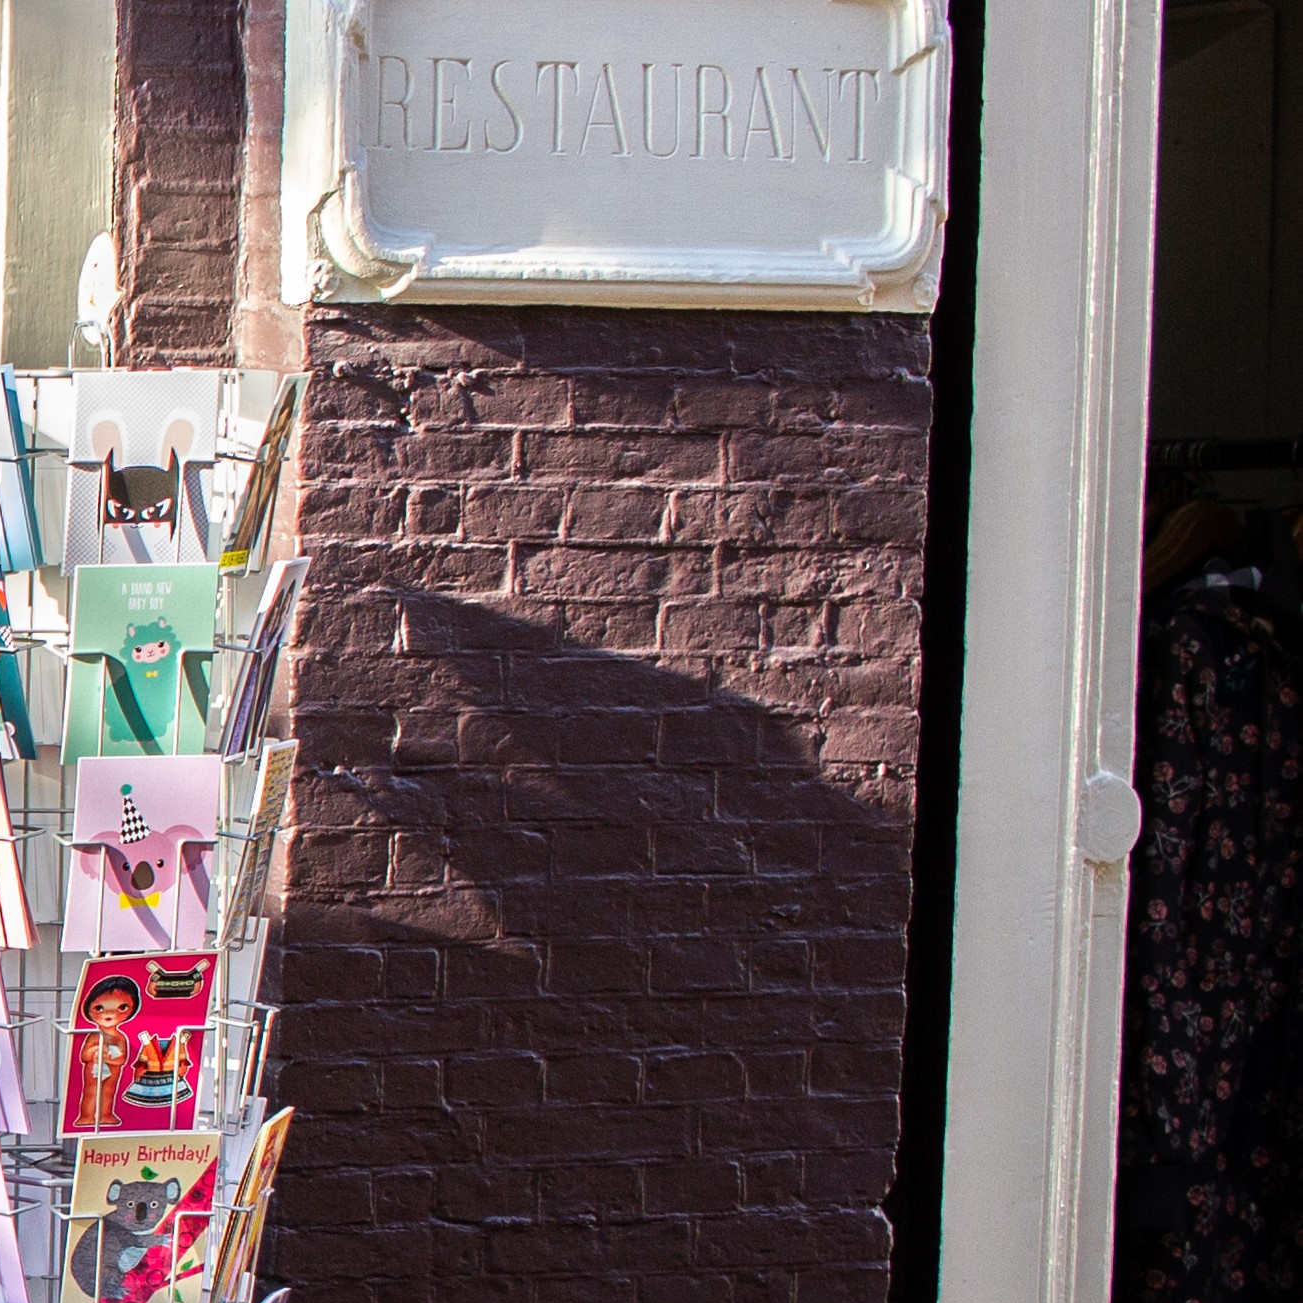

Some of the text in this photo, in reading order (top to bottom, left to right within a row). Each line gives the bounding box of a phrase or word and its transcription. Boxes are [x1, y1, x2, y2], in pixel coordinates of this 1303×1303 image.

[372, 55, 881, 165] RESTAURANT
[156, 581, 172, 595] NEW
[128, 597, 164, 611] BABY BOY
[83, 1144, 211, 1167] Happy Birthday!
